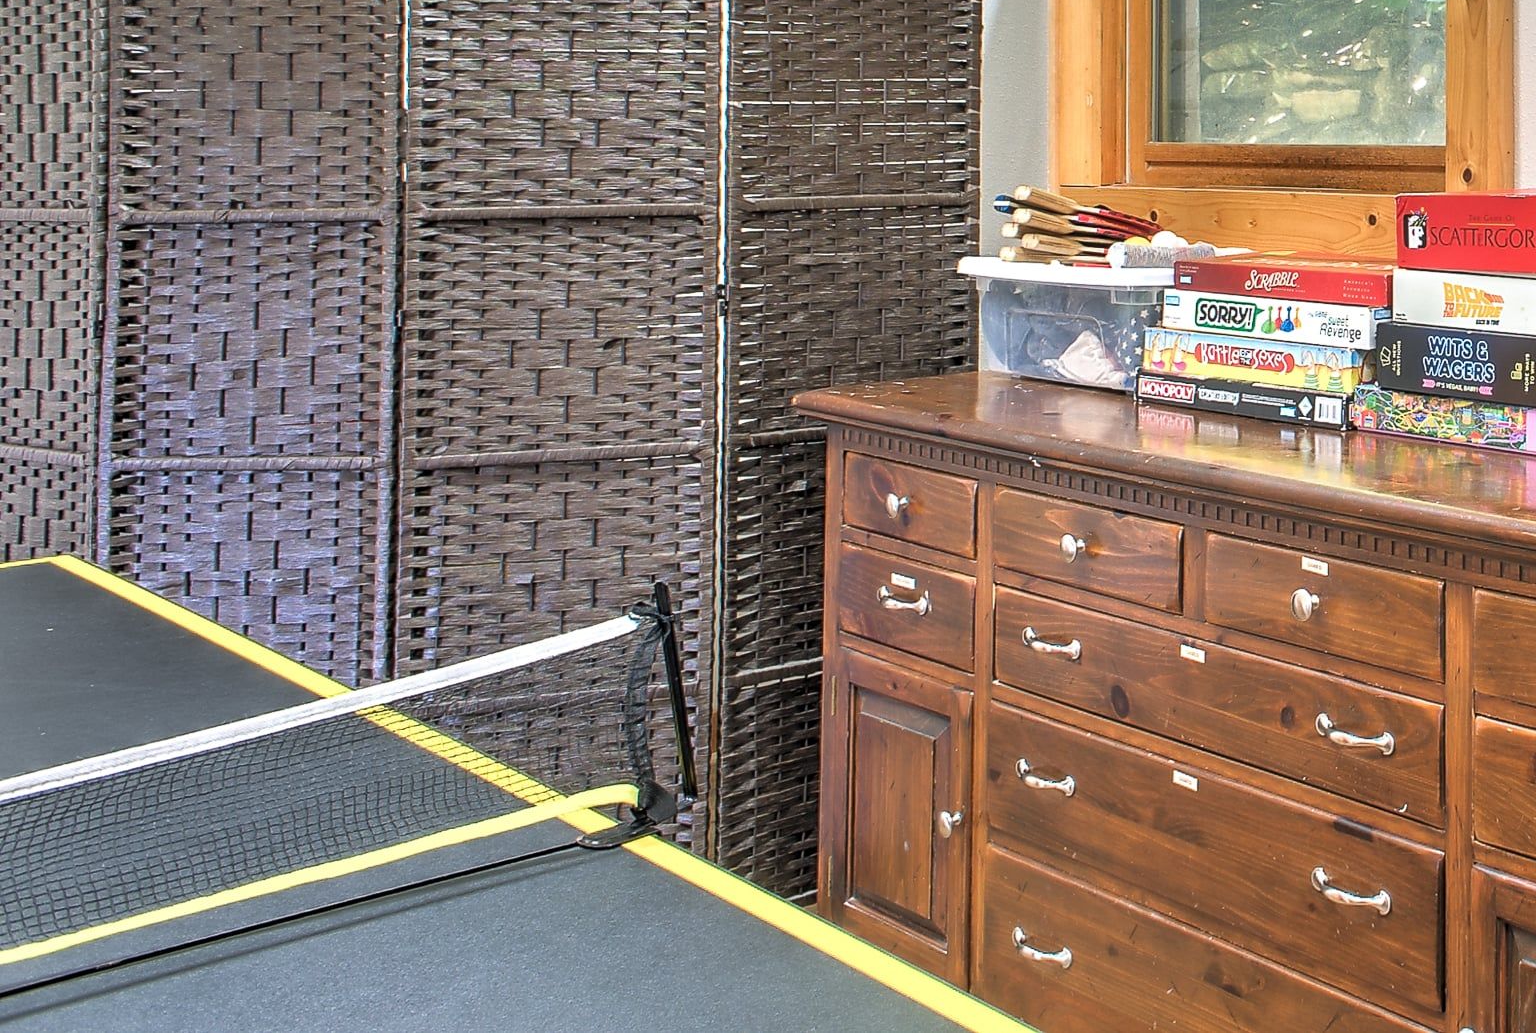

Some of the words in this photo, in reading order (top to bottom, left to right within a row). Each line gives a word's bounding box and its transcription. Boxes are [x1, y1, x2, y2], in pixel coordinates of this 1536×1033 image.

[1244, 269, 1300, 292] SCRABBLE
[1443, 282, 1491, 306] BACK
[1199, 303, 1253, 327] SORRY!
[1445, 302, 1455, 311] TO
[1454, 303, 1503, 318] FUTURE
[1319, 322, 1362, 343] Revenge
[1427, 335, 1473, 359] WITS
[1476, 341, 1489, 361] &
[1422, 356, 1496, 384] WAGERS
[1140, 379, 1194, 401] MONOPOLY
